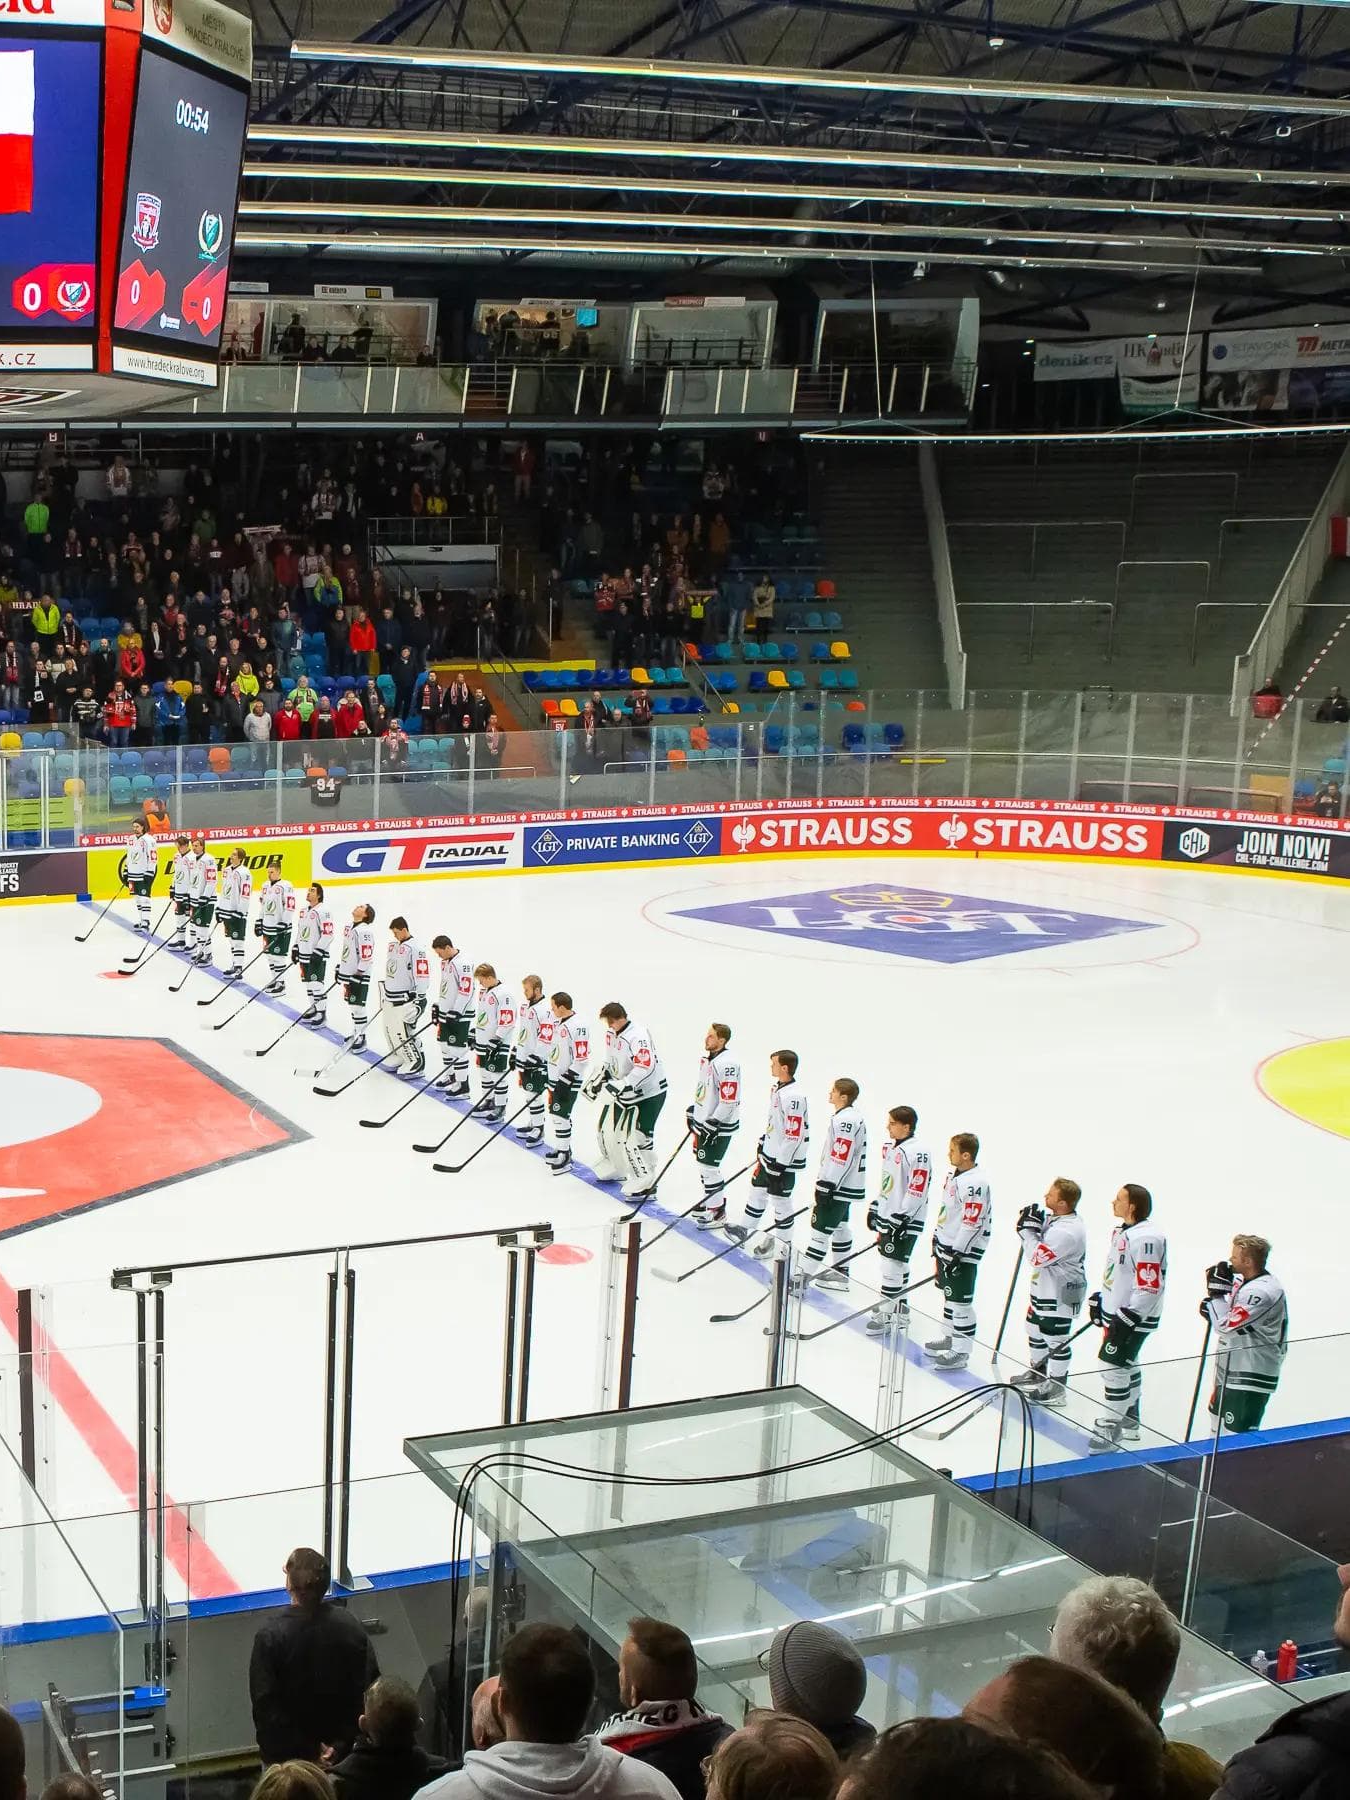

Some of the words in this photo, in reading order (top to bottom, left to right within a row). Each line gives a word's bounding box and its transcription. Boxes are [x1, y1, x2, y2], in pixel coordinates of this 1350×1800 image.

[176, 99, 210, 136] 00:54
[23, 283, 42, 311] 0
[131, 279, 141, 305] 0
[202, 297, 211, 321] 0
[127, 355, 206, 382] www.hradeckralove.org
[316, 778, 336, 791] 94
[209, 827, 248, 838] STRAUSS
[265, 824, 304, 835] STRAUSS
[320, 821, 358, 832] STRAUSS
[374, 818, 412, 829] STRAUSS
[428, 816, 465, 826] STRAUSS
[480, 814, 516, 824] STRAUSS
[531, 811, 567, 821] STRAUSS
[582, 809, 617, 819] STRAUSS
[632, 806, 667, 817] STRAUSS
[681, 804, 715, 814] STRAUSS
[729, 801, 763, 811] STRAUSS
[777, 799, 812, 809] STRAUSS
[827, 799, 865, 807] STRAUSS
[881, 798, 919, 807] STRAUSS
[937, 799, 977, 808] STRAUSS
[995, 800, 1036, 809] STRAUSS
[1053, 802, 1096, 812] STRAUSS
[1113, 804, 1157, 815] STRAUSS
[1175, 807, 1218, 819] STRAUSS
[1236, 811, 1279, 824] STRAUSS
[1297, 816, 1340, 829] STRAUSS
[566, 836, 618, 851] PRIVATE
[622, 832, 680, 848] BANKING
[688, 832, 708, 844] LGT
[760, 816, 913, 847] STRAUSS
[972, 818, 1149, 853] STRAUSS
[321, 836, 428, 874] GT
[428, 844, 510, 860] RADIAL
[537, 841, 559, 853] LGT
[1236, 830, 1278, 856] JOIN
[1282, 834, 1331, 861] NOW!
[967, 1186, 982, 1198] 34
